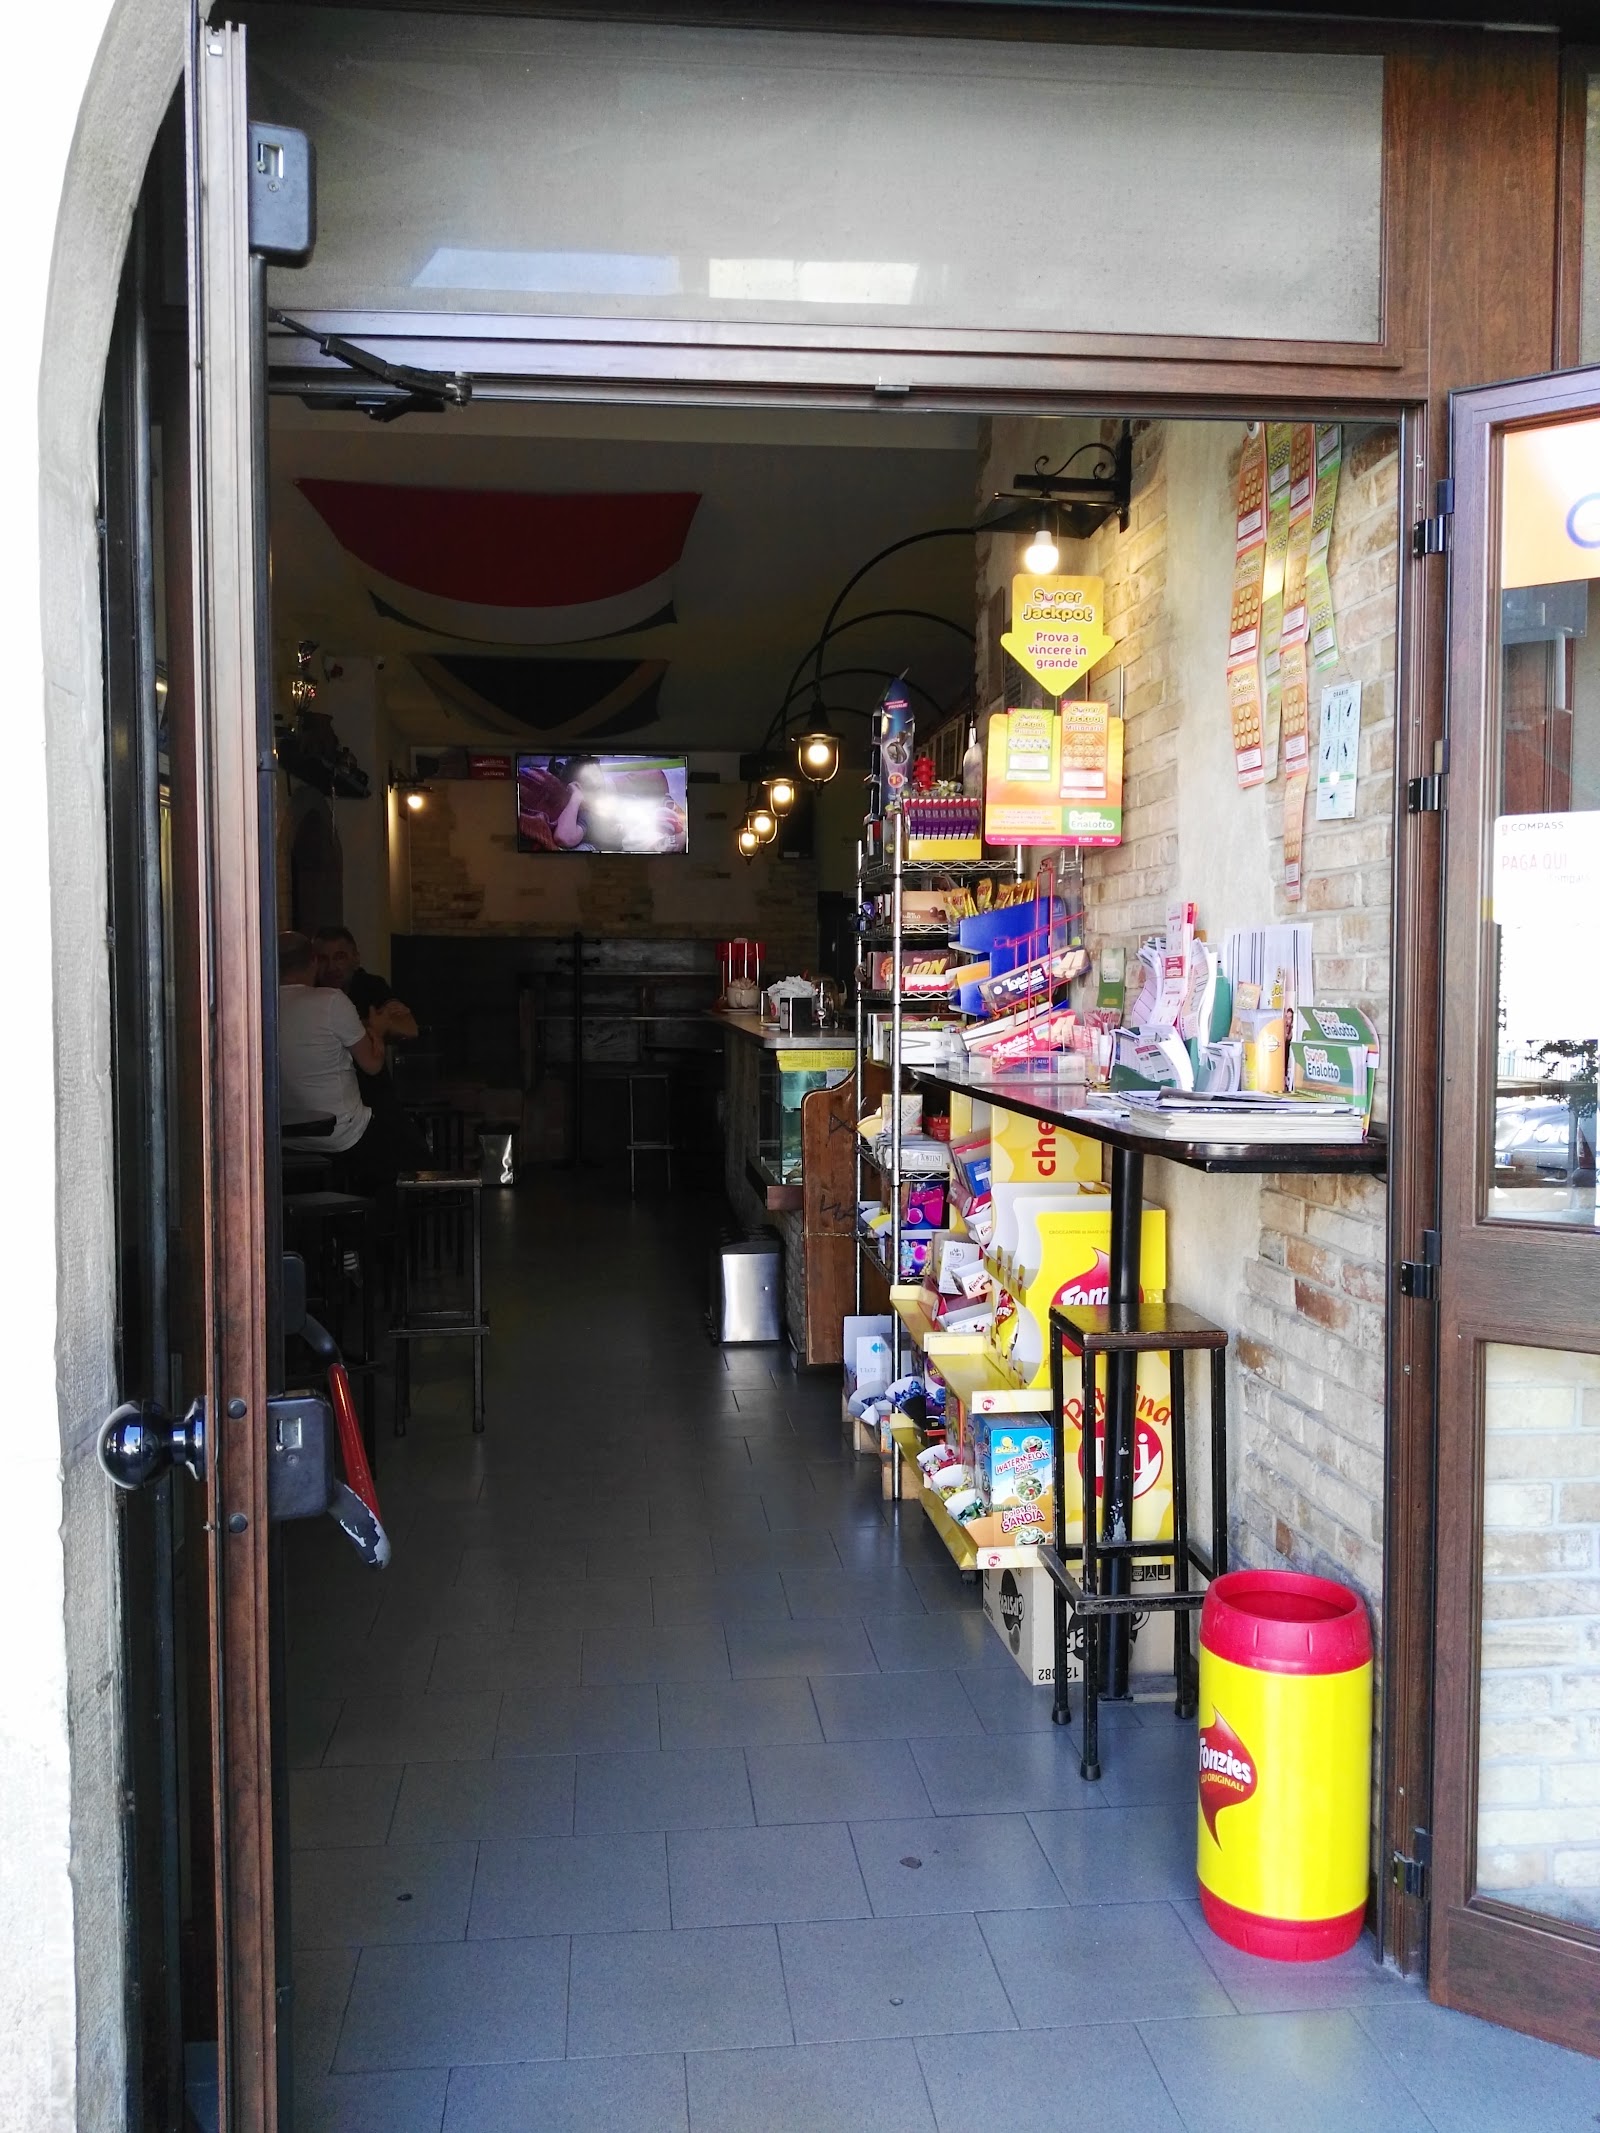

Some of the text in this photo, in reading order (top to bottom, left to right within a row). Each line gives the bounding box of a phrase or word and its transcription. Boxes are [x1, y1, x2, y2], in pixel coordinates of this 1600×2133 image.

[1034, 589, 1082, 605] Super
[1023, 604, 1092, 622] Jackpot
[1036, 632, 1069, 642] Prova
[1028, 645, 1087, 655] vincere in
[1036, 658, 1078, 669] grande
[1511, 821, 1564, 832] COMPASS
[1502, 852, 1568, 871] PAGA QUI
[902, 957, 949, 975] LION
[1321, 1023, 1357, 1038] Enalotto
[1308, 1063, 1339, 1079] Enalotto
[995, 1450, 1050, 1475] WATERMELON
[1207, 1775, 1244, 1793] ORIGINALI
